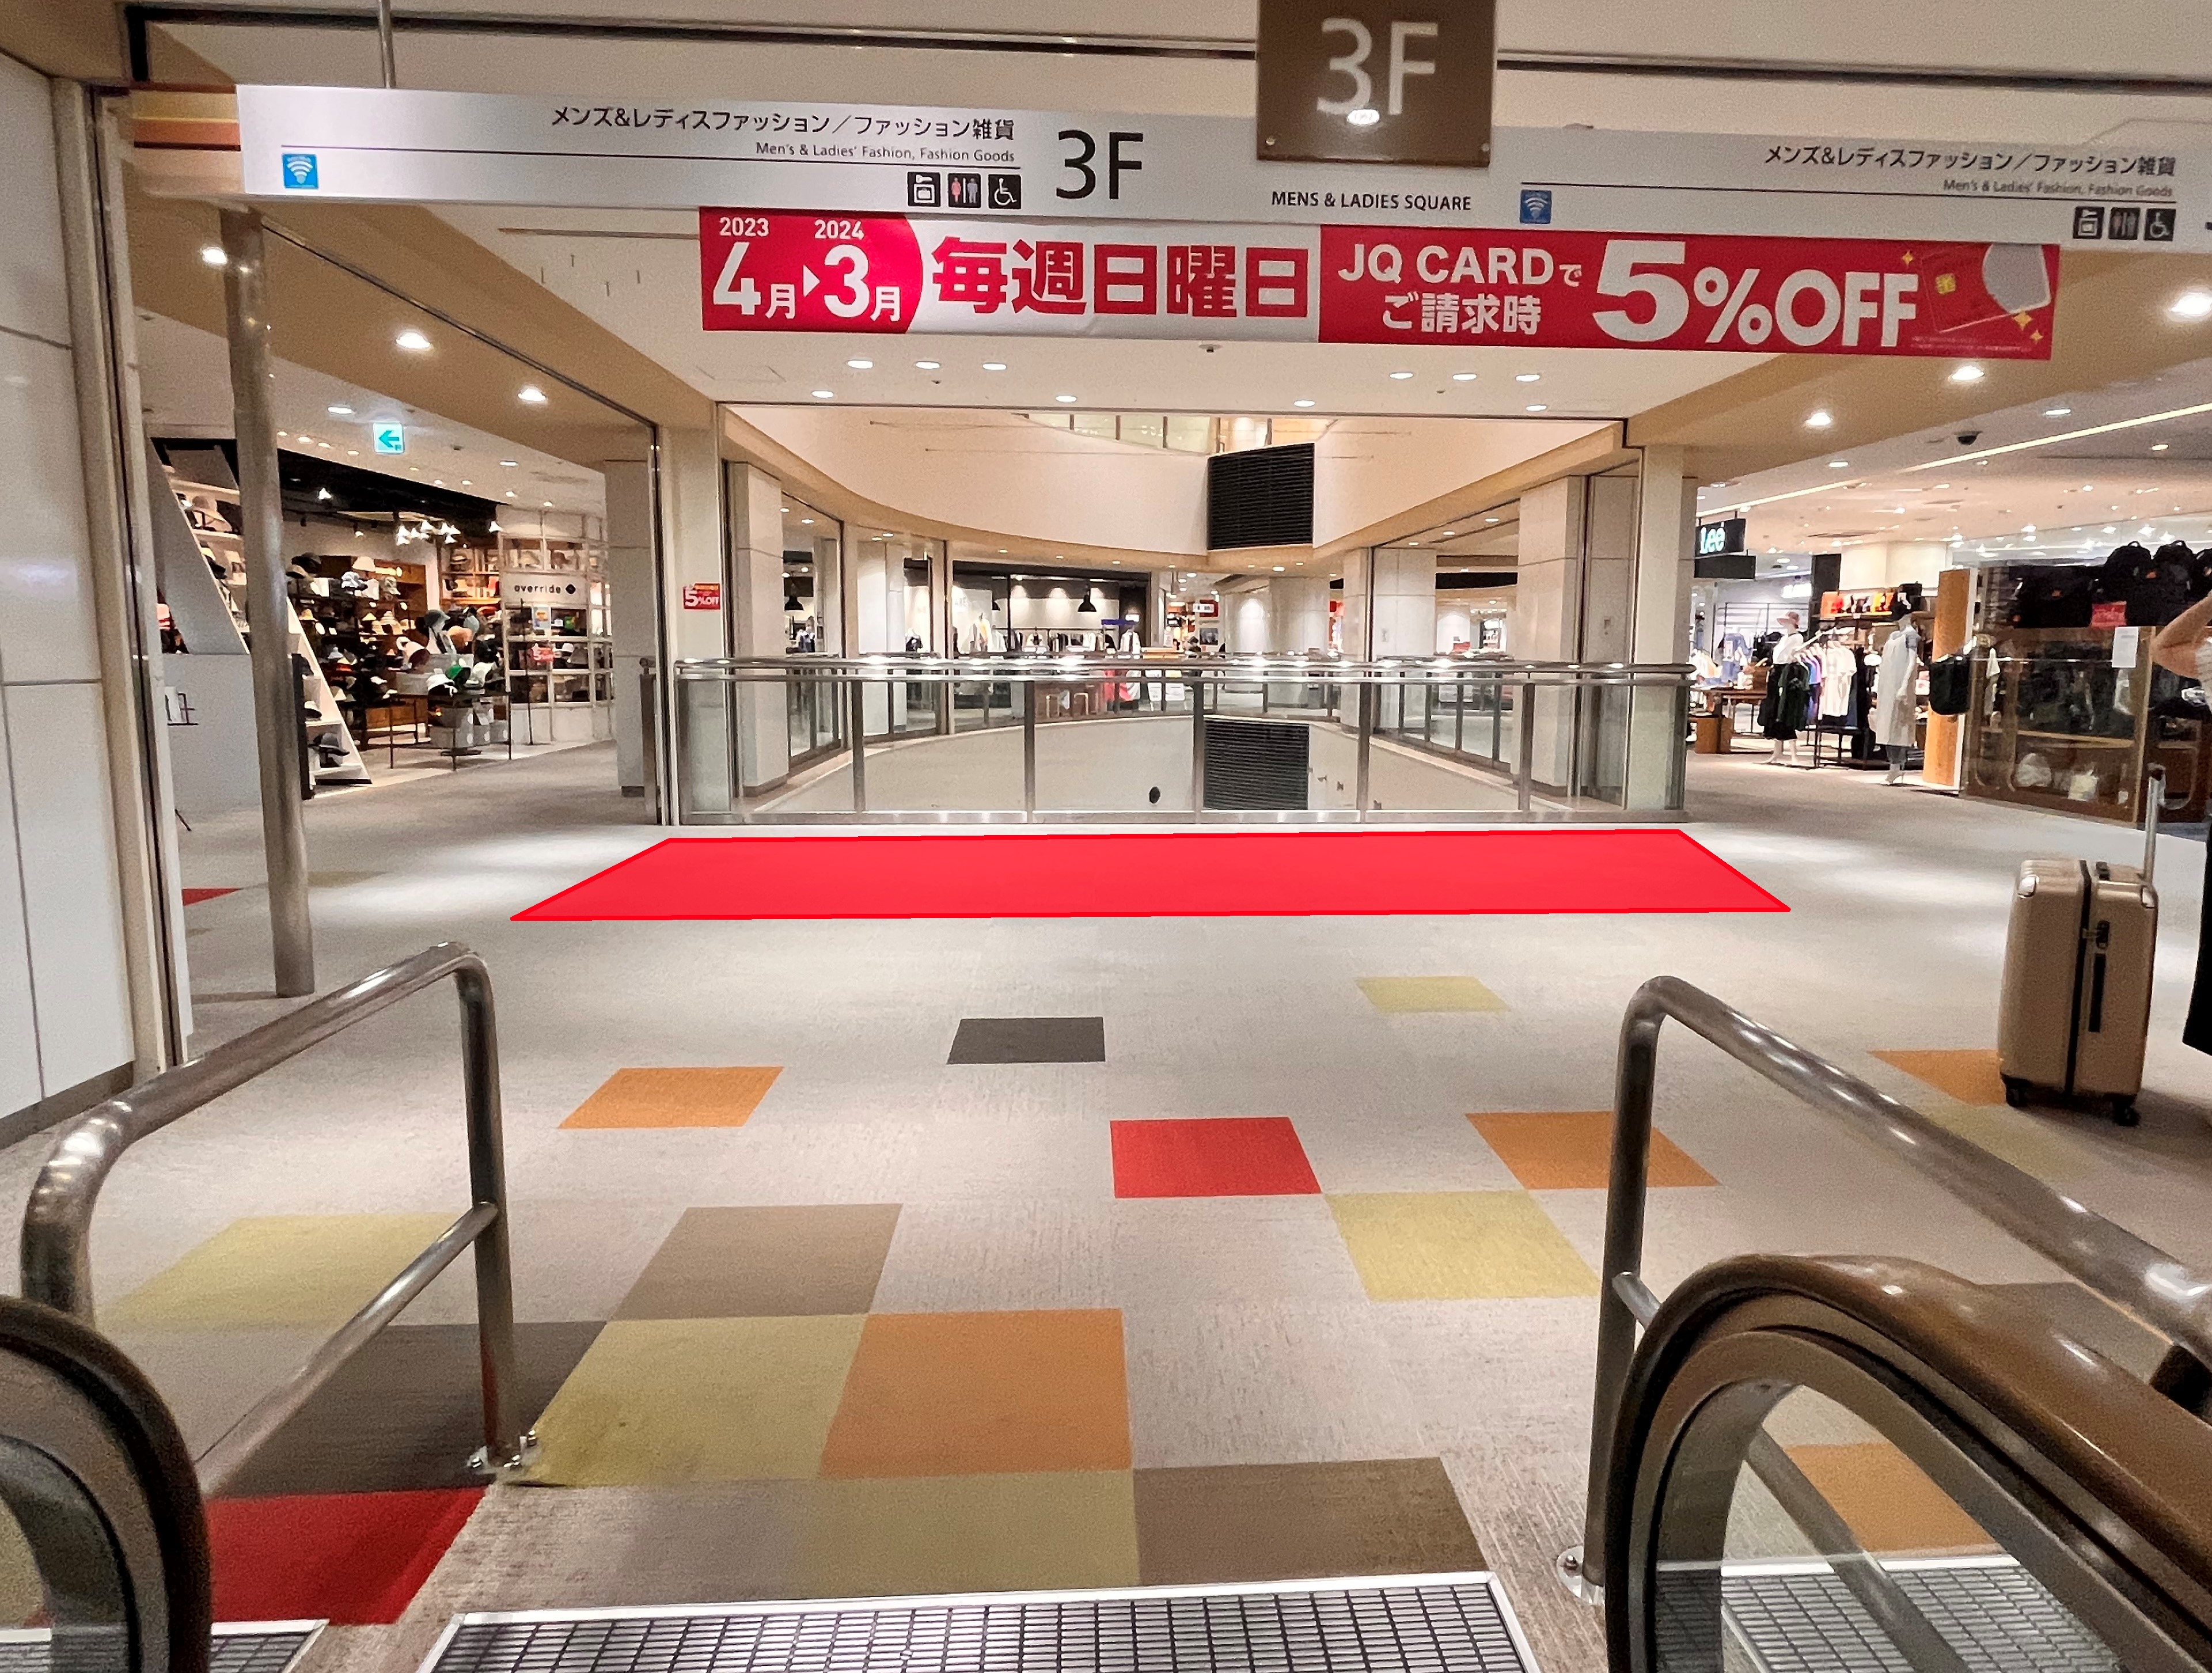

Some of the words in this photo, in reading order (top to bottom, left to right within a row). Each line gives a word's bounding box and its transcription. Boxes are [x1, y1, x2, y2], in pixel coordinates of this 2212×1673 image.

[1317, 18, 1439, 116] 3F
[756, 142, 795, 155] Men's
[799, 144, 809, 155] &
[813, 145, 858, 157] Ladies'
[862, 146, 915, 161] Fashion,
[920, 147, 969, 161] Fashion
[974, 150, 1015, 162] Goods
[1056, 130, 1144, 200] 3F
[1272, 191, 1319, 207] MENS
[1324, 193, 1335, 207] &
[1341, 193, 1399, 209] LADIES
[1404, 195, 1471, 211] SQUARE
[1943, 179, 1978, 192] Men's
[1982, 181, 1990, 191] &
[2036, 182, 2085, 196] Fashion,
[2088, 184, 2133, 196] Fashion
[2137, 186, 2173, 198] Goods
[719, 217, 769, 237] 2023
[814, 220, 864, 240] 2024
[932, 235, 1308, 317] 毎週日曜日
[1337, 244, 1403, 283] JQ
[713, 242, 795, 319] 4月
[824, 244, 901, 322] 3月
[1592, 239, 1919, 347] 5%OFF
[1383, 291, 1541, 336] ご請求時
[1699, 526, 1725, 554] Lee
[514, 585, 561, 594] override
